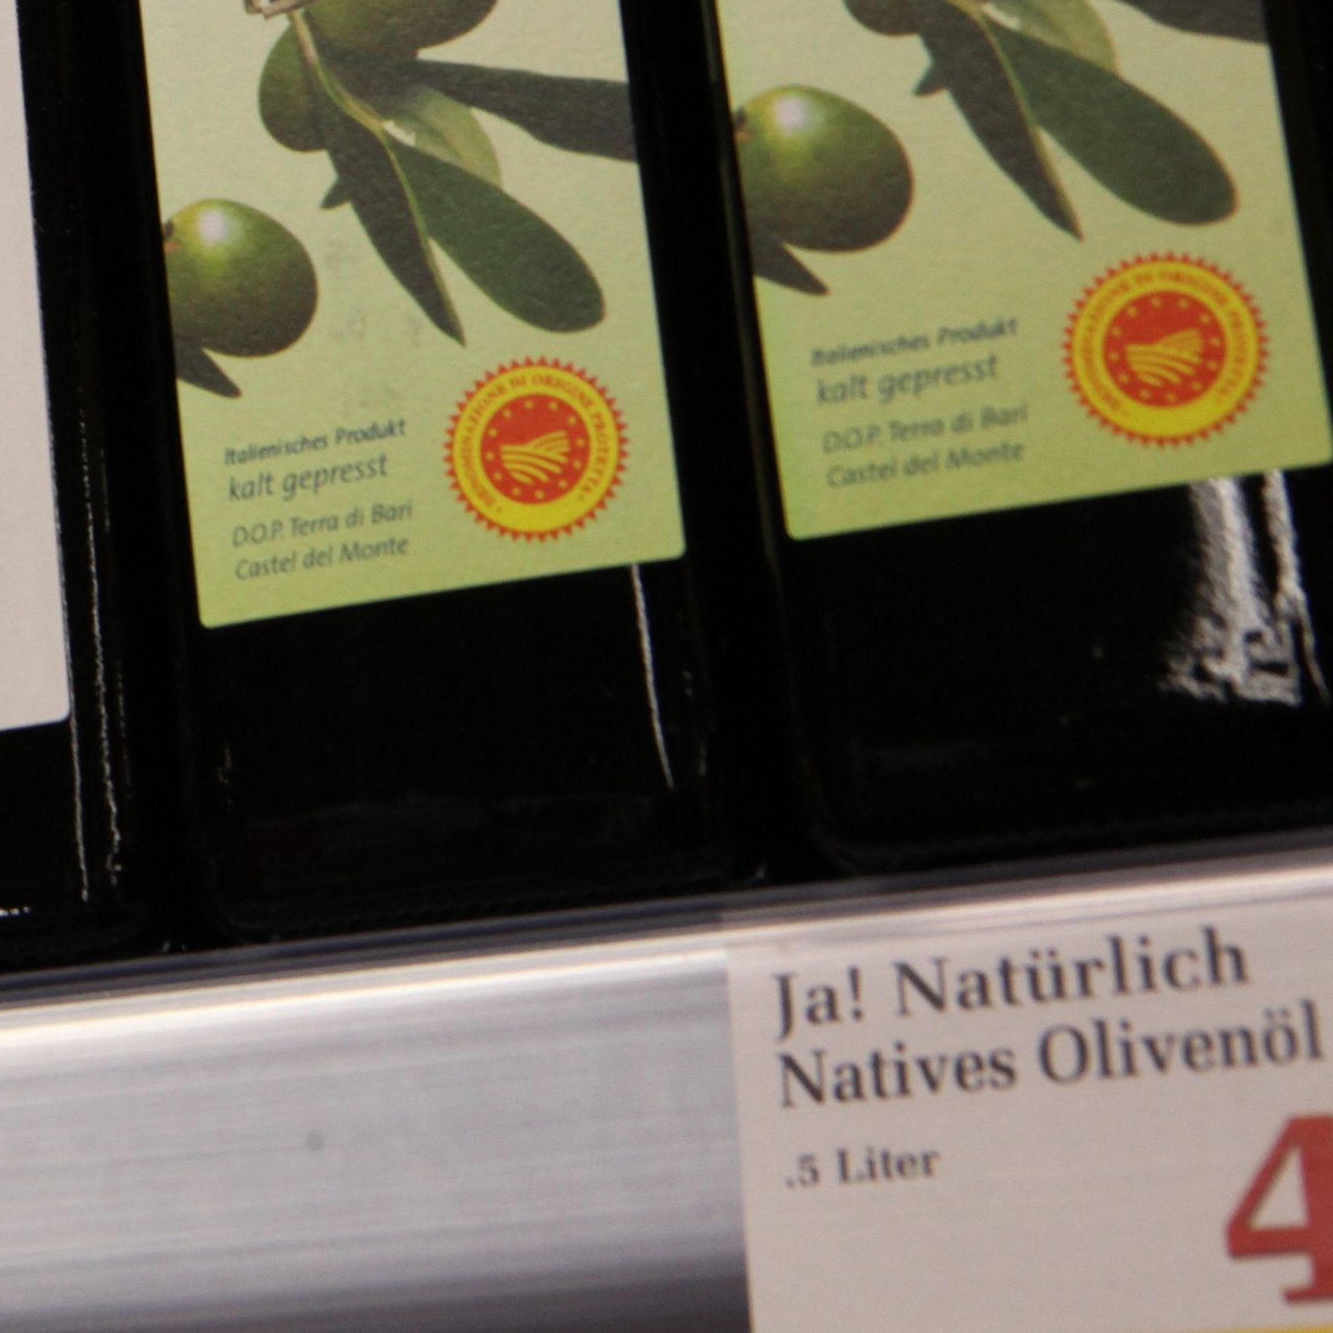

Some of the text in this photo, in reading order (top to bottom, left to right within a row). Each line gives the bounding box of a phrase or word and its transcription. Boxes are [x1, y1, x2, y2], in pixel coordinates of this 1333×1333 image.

[878, 354, 998, 404] gepresst
[335, 419, 407, 446] Produkt
[228, 454, 388, 502] kalt gepresst
[340, 535, 409, 564] Monte
[774, 924, 1249, 1044] Ja! Natürlich
[778, 998, 1324, 1110] Natives Olivenöl
[785, 1146, 941, 1188] .5 Liter
